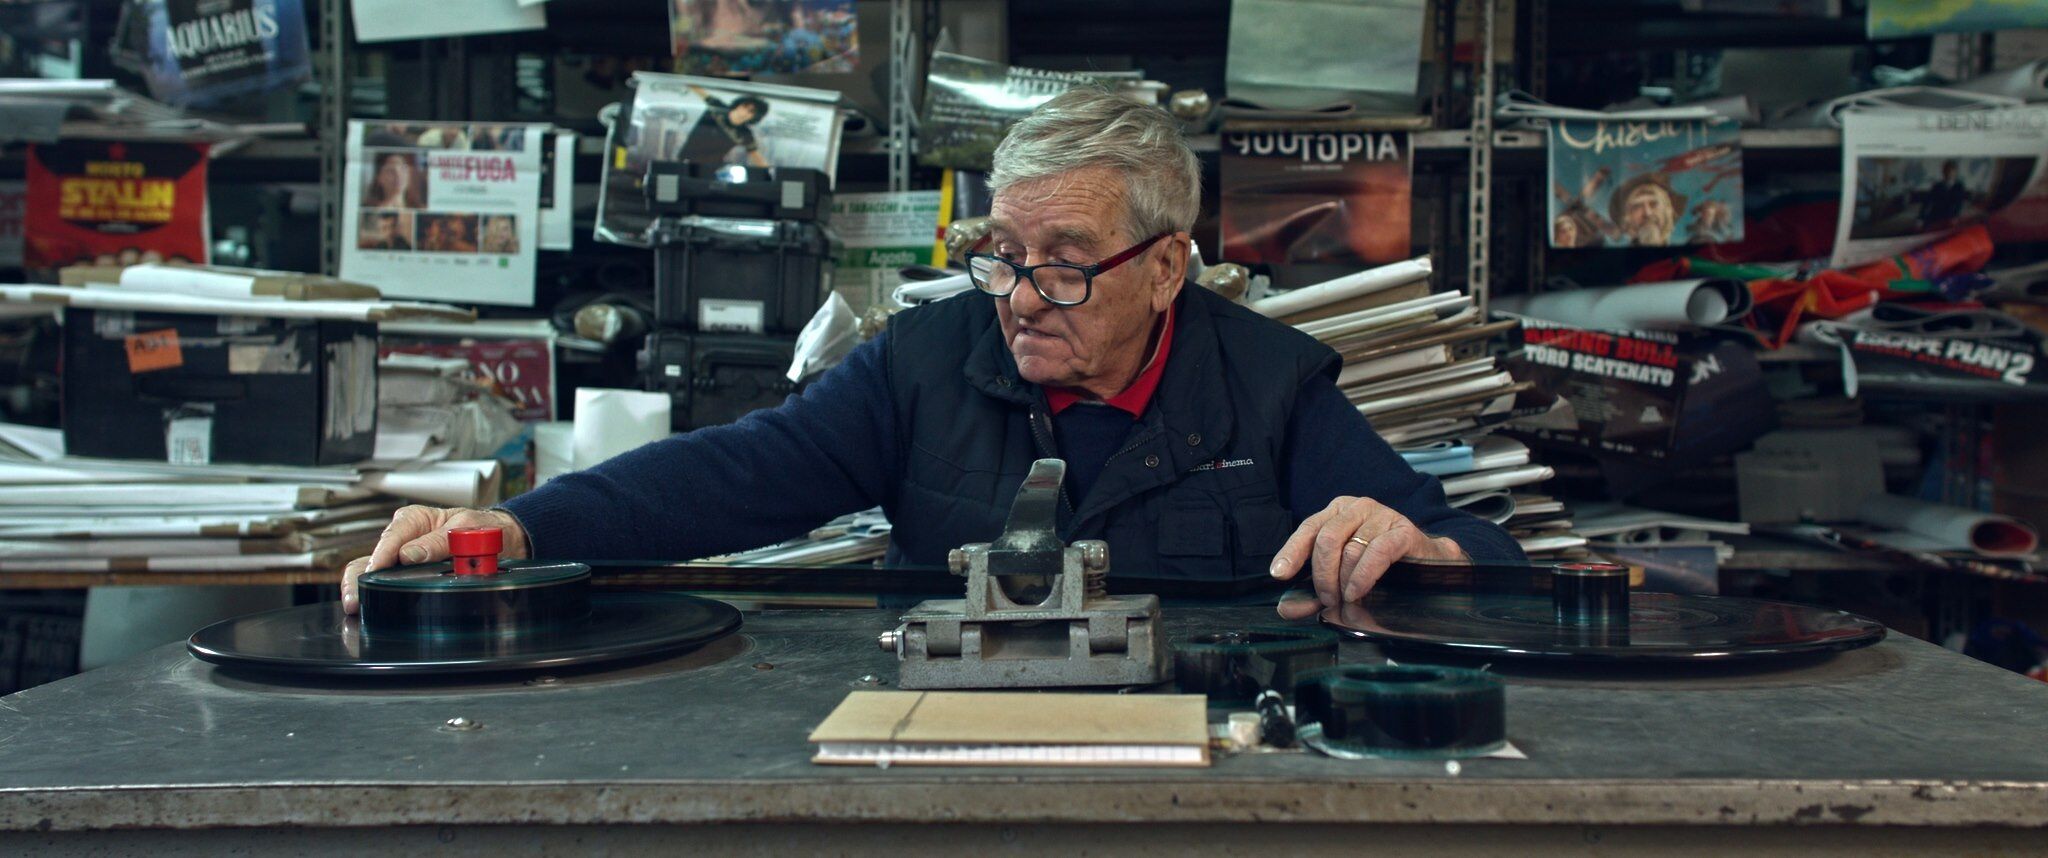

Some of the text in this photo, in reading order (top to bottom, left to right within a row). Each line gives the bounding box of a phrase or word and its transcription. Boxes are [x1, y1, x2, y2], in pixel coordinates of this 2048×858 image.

[166, 4, 279, 58] AQUARIUS
[465, 156, 516, 182] FUGA
[61, 177, 175, 208] STALIN
[868, 250, 917, 267] Agosto
[1524, 343, 1675, 388] TORO SCATENATO
[1616, 336, 1679, 369] BULL
[1944, 339, 2010, 371] PLAN
[2003, 352, 2035, 387] 2
